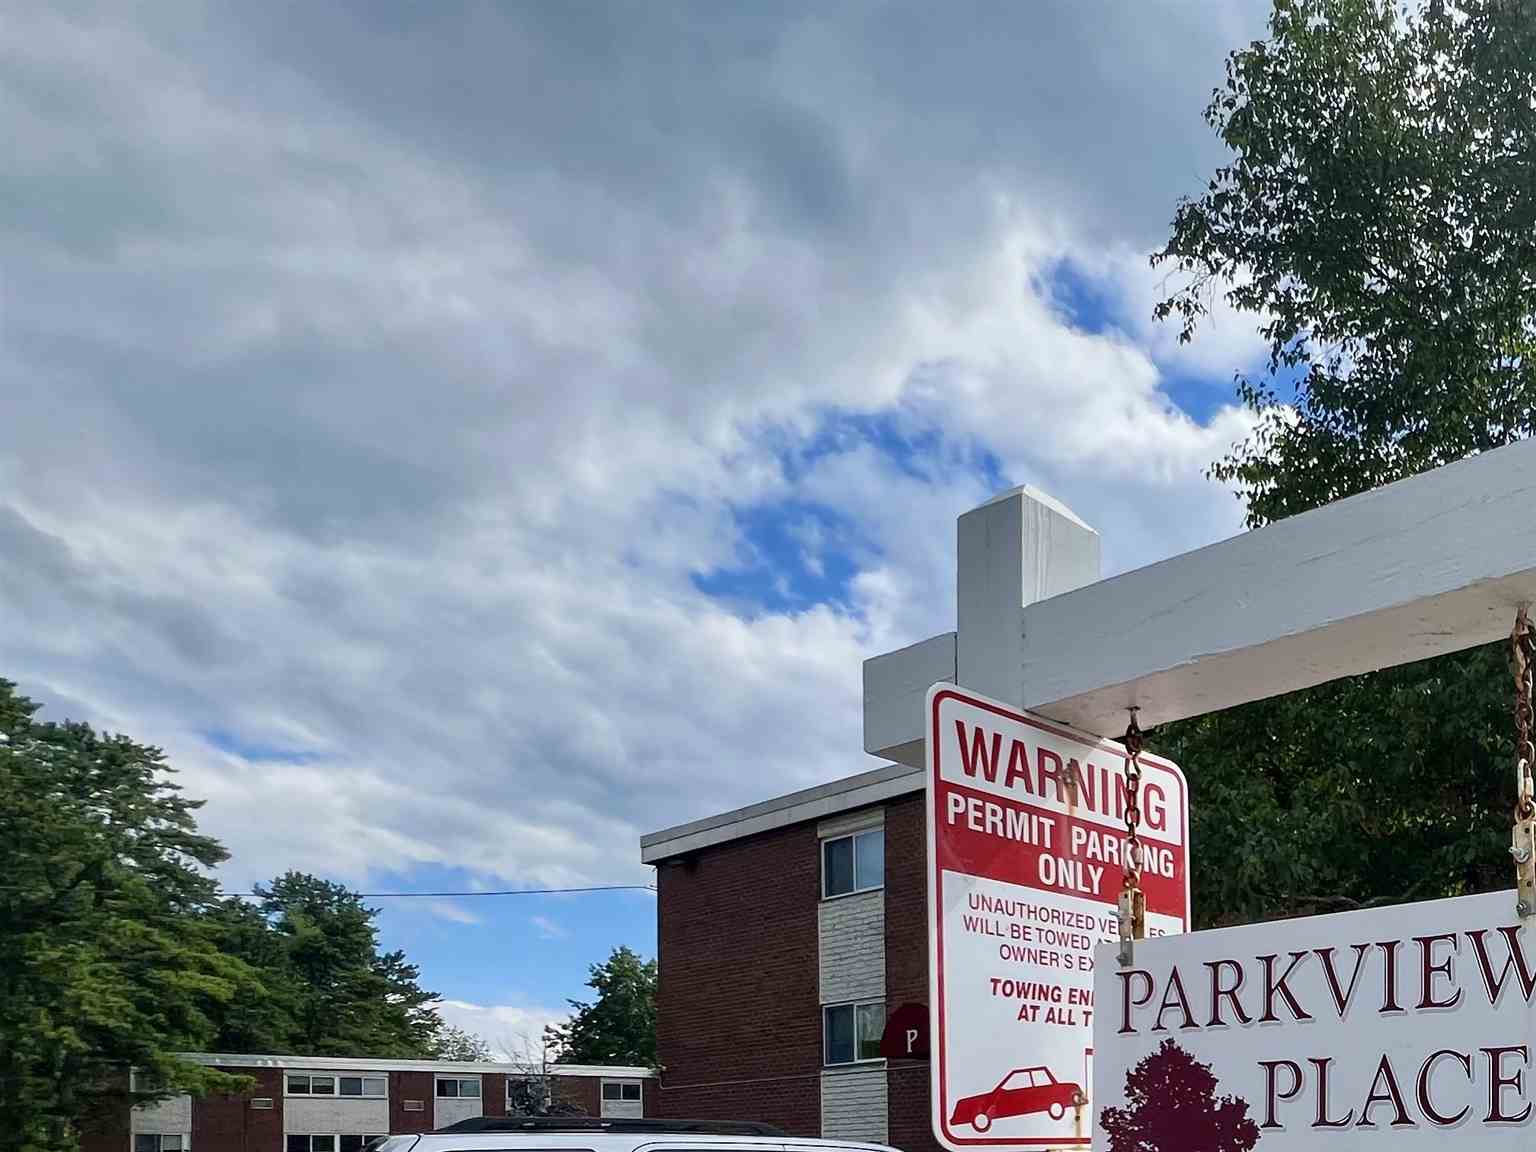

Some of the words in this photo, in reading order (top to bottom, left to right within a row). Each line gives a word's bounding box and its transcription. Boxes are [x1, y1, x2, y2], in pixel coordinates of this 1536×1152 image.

[955, 719, 1167, 832] WARNING
[947, 791, 1055, 849] PERMIT
[1071, 825, 1174, 879] PARKNG
[1038, 853, 1104, 895] ONLY
[968, 893, 1095, 930] UNAUTHORIZED
[964, 914, 1005, 937] WILL
[1010, 923, 1032, 942] BE
[1035, 927, 1091, 950] TOWED
[1000, 944, 1074, 970] OWNER'S
[990, 977, 1062, 1003] TOWING
[1017, 1004, 1041, 1022] AT
[1045, 1008, 1076, 1026] ALL
[1257, 1044, 1535, 1130] PLACE
